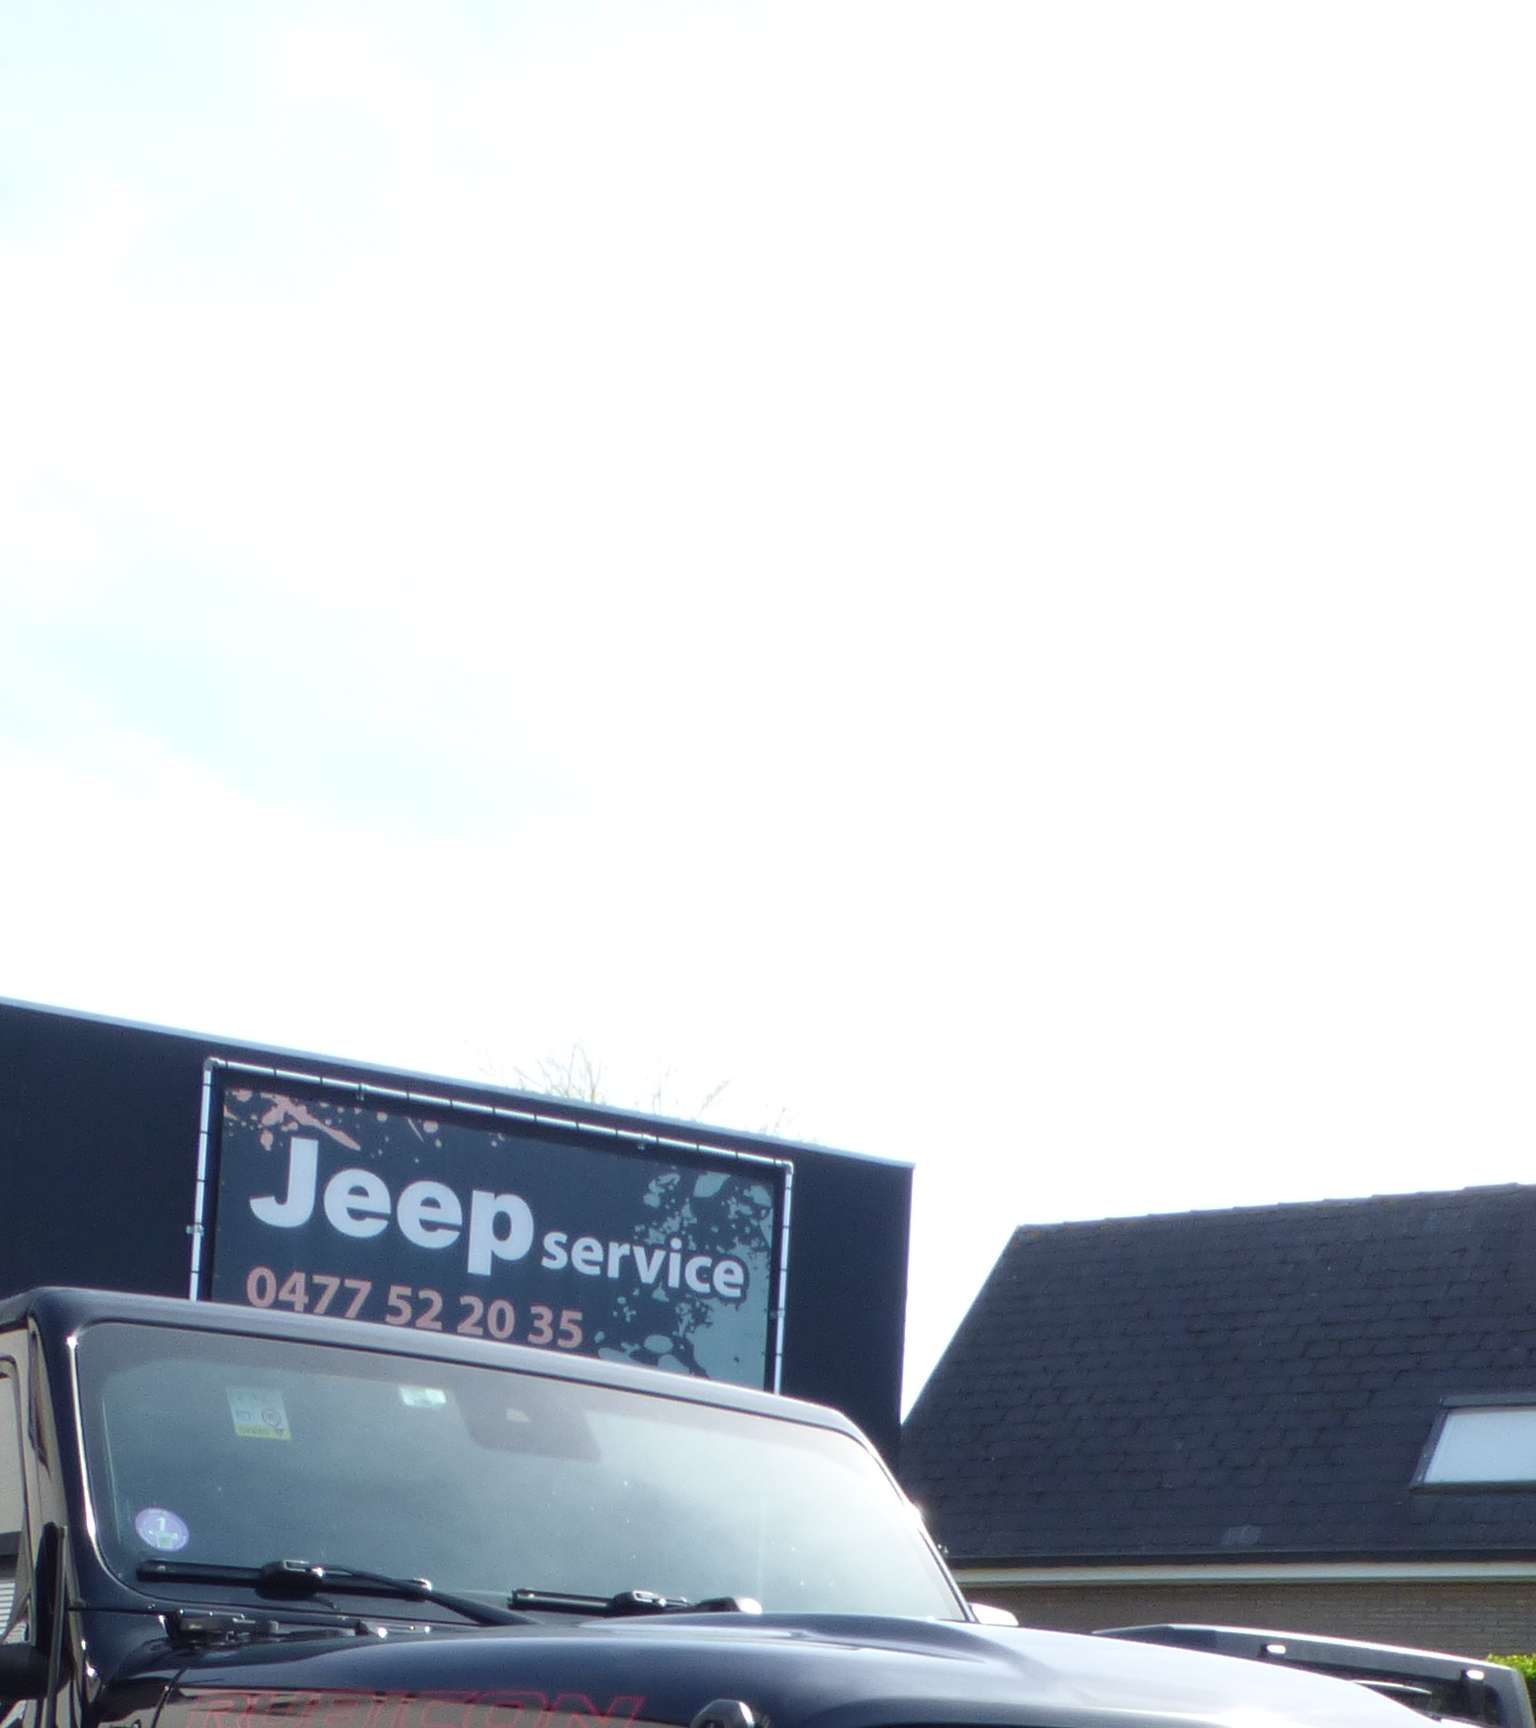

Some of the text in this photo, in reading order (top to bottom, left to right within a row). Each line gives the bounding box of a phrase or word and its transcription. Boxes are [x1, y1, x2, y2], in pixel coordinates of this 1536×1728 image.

[249, 1137, 745, 1298] Jeep service
[246, 1266, 583, 1349] 0477 52 20 35
